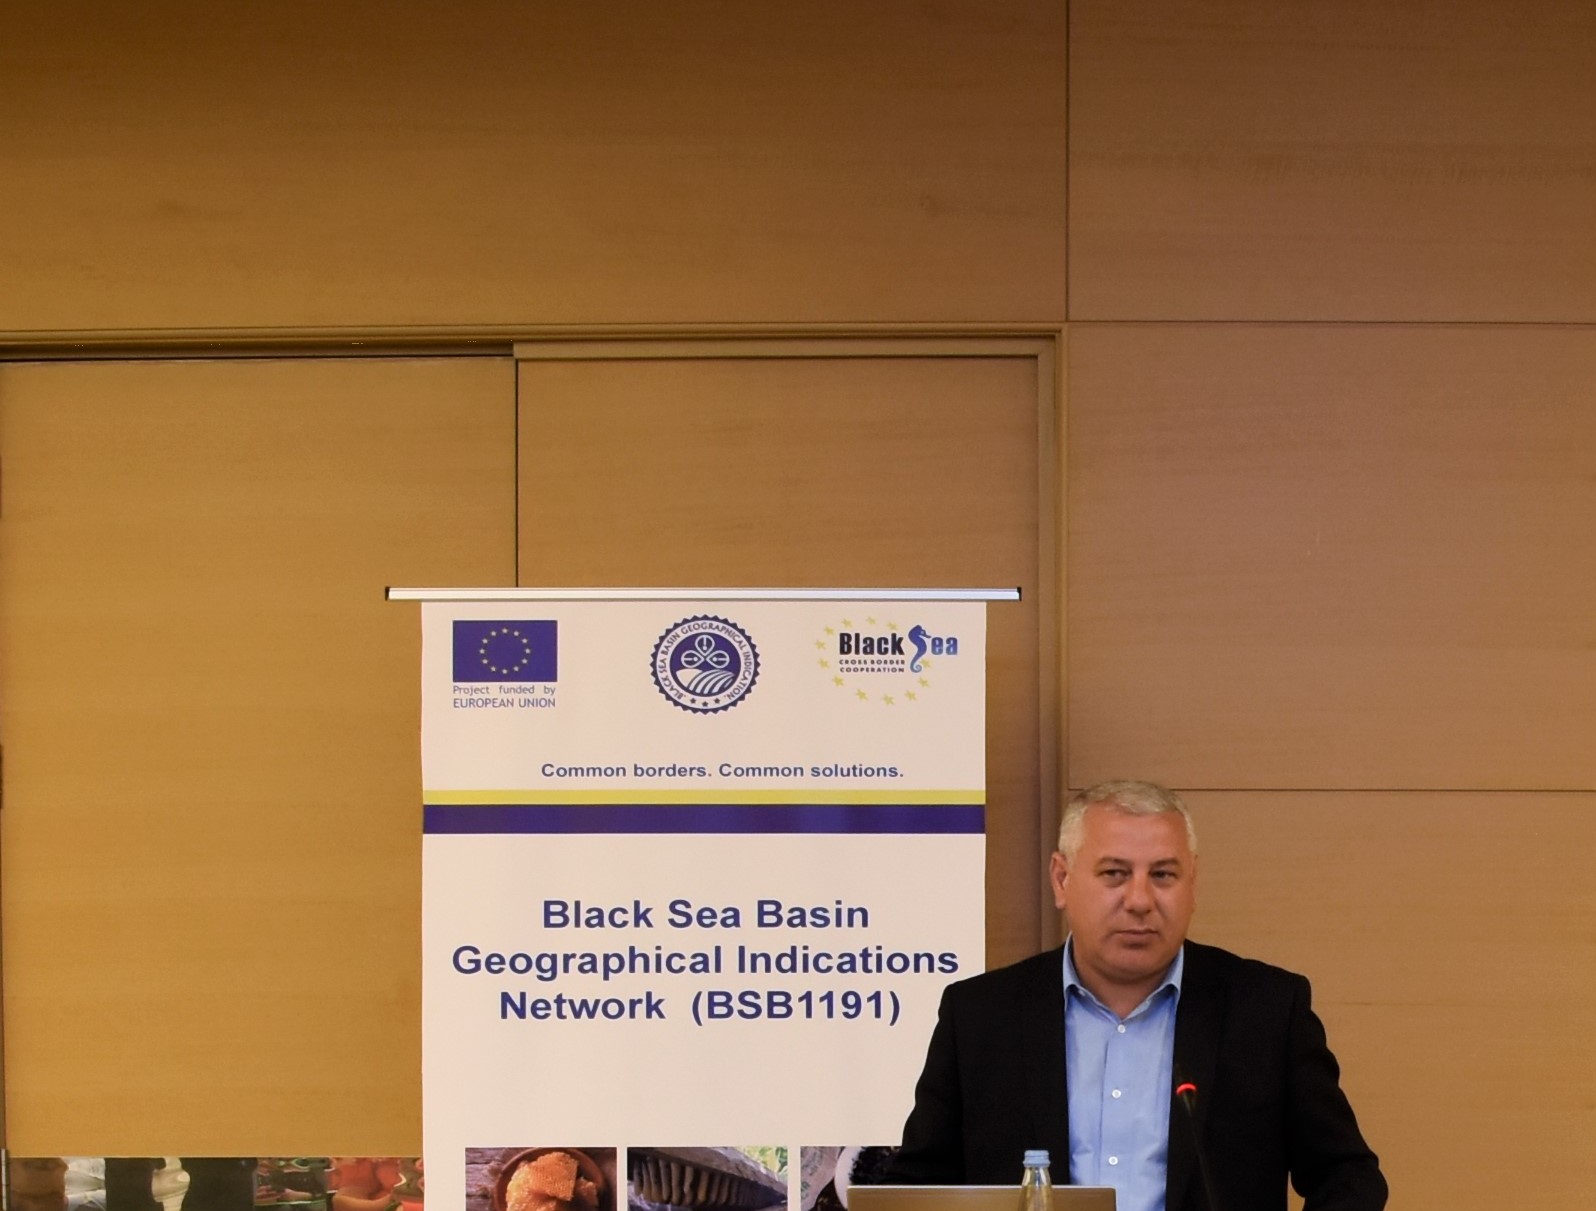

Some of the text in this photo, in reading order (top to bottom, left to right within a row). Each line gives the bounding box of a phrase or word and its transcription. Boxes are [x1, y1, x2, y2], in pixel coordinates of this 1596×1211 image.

[660, 632, 680, 655] BASIN
[681, 621, 746, 651] GEOGRAPHICAL
[839, 632, 905, 655] Black
[453, 685, 556, 696] Project funded by
[453, 698, 556, 708] EUROPEAN UNION
[541, 762, 904, 778] Common borders. Common solutions.
[543, 900, 870, 929] Black Sea Basin
[452, 945, 960, 982] Geographical Indications
[499, 990, 902, 1027] Network (BSB1191)
